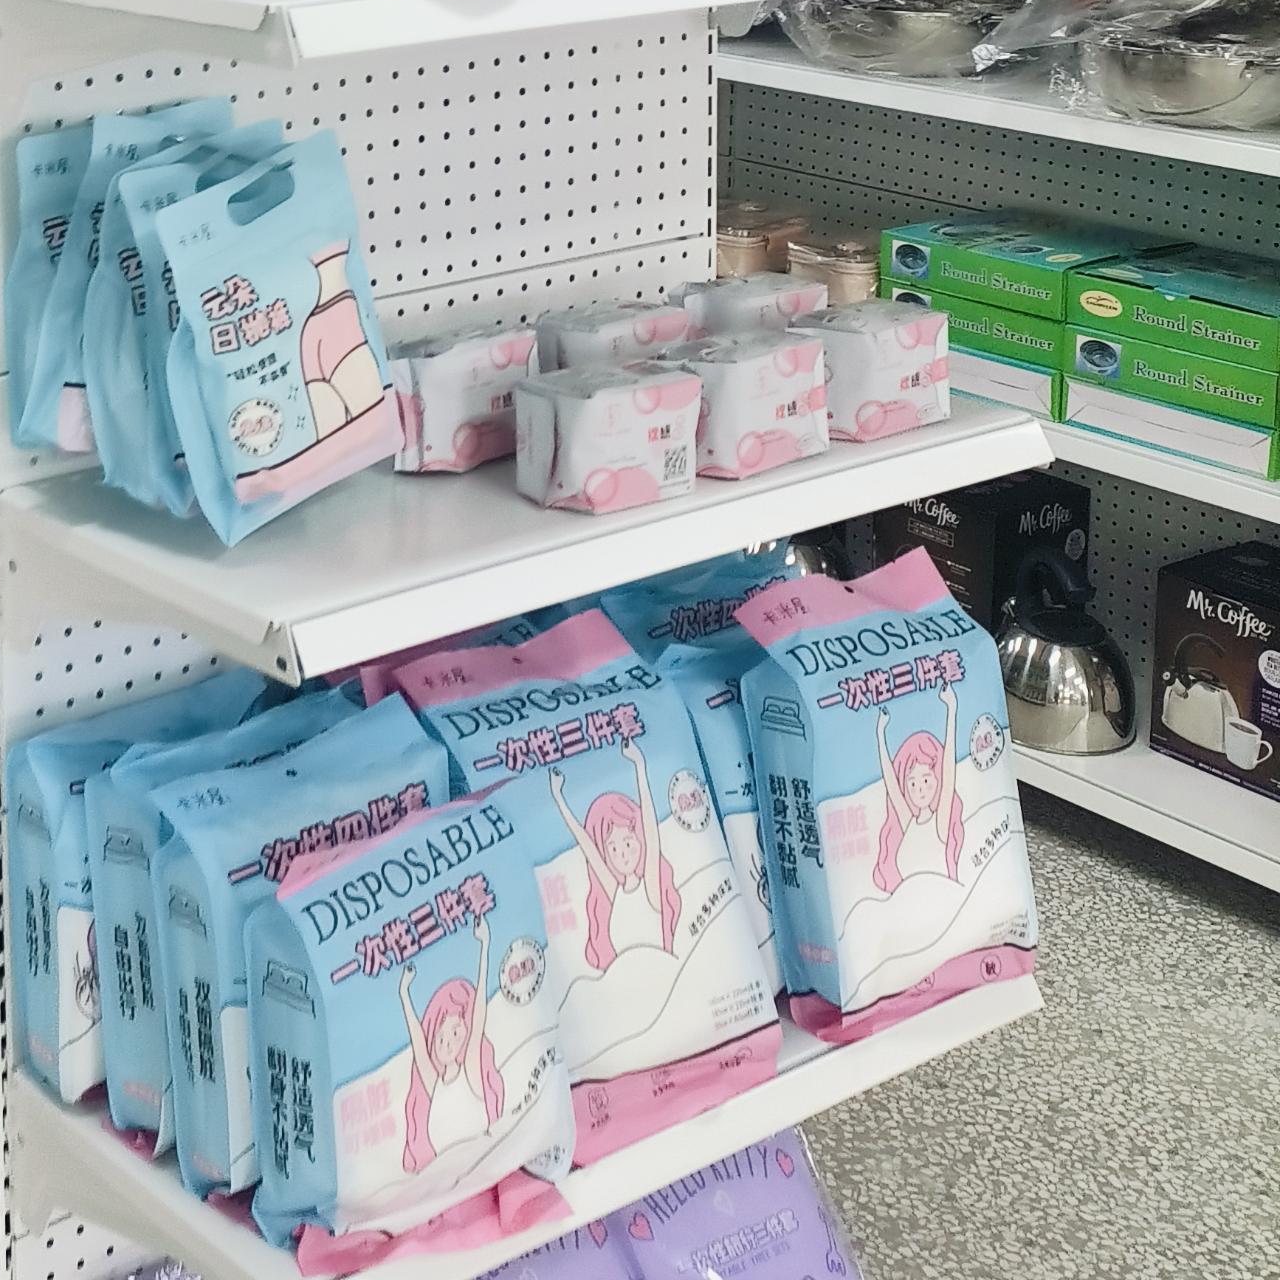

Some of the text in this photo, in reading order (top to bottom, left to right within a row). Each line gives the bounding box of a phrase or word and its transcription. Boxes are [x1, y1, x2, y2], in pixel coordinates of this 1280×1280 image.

[939, 260, 1052, 302] Round Strainer
[992, 322, 1054, 352] Strainer
[1133, 305, 1187, 333] Round
[1191, 320, 1261, 350] Strainer
[1133, 359, 1264, 406] Round Strainer
[924, 498, 960, 526] Coffee
[1039, 503, 1072, 535] Coffee
[1186, 589, 1272, 638] Mr. Coffee
[786, 609, 977, 677] DISPOSABLE
[817, 648, 966, 712] 一次性三件套
[473, 701, 646, 773] 一次性三件套
[791, 777, 824, 869] 舒适透气
[301, 804, 515, 946] DISPOSABLE
[330, 871, 496, 986] 一次性三件套
[642, 1169, 706, 1225] HELLO
